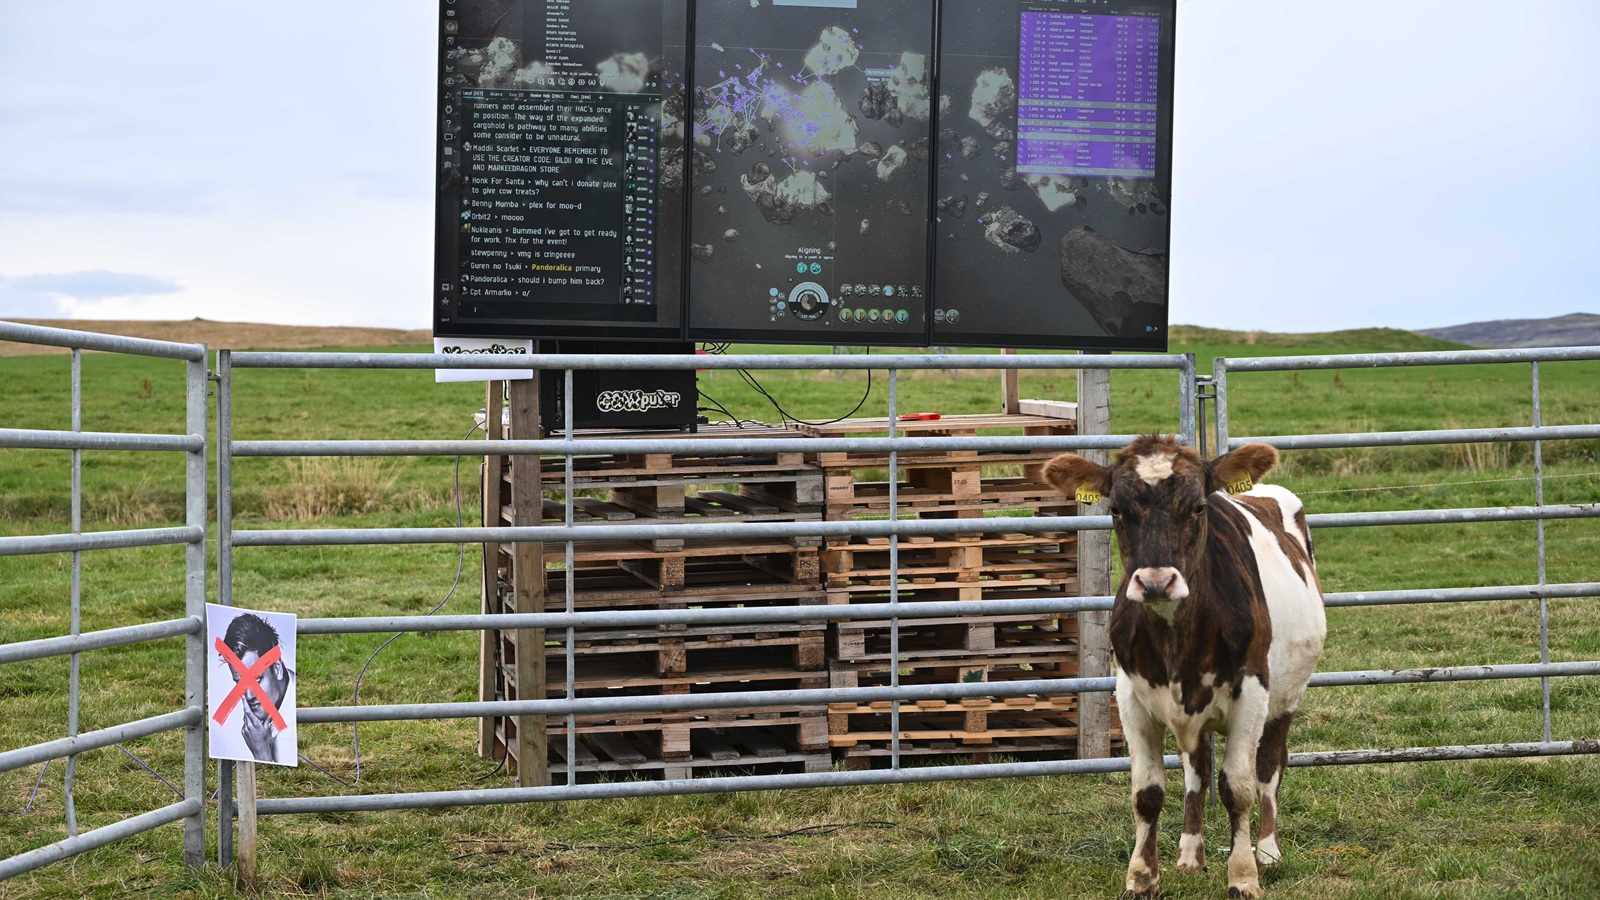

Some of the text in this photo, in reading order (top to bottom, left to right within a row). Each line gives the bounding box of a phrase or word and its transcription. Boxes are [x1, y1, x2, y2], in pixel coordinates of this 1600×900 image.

[517, 123, 547, 132] pathway
[581, 124, 608, 132] abilities
[601, 157, 614, 166] EVE
[534, 179, 549, 188] why
[482, 187, 496, 195] give
[472, 200, 492, 208] Benny
[558, 229, 571, 237] got
[583, 229, 595, 237] get
[598, 230, 617, 238] ready
[548, 277, 567, 285] bump
[470, 288, 482, 296] Cpt
[1227, 480, 1252, 495] 0405
[1076, 492, 1100, 502] 0405
